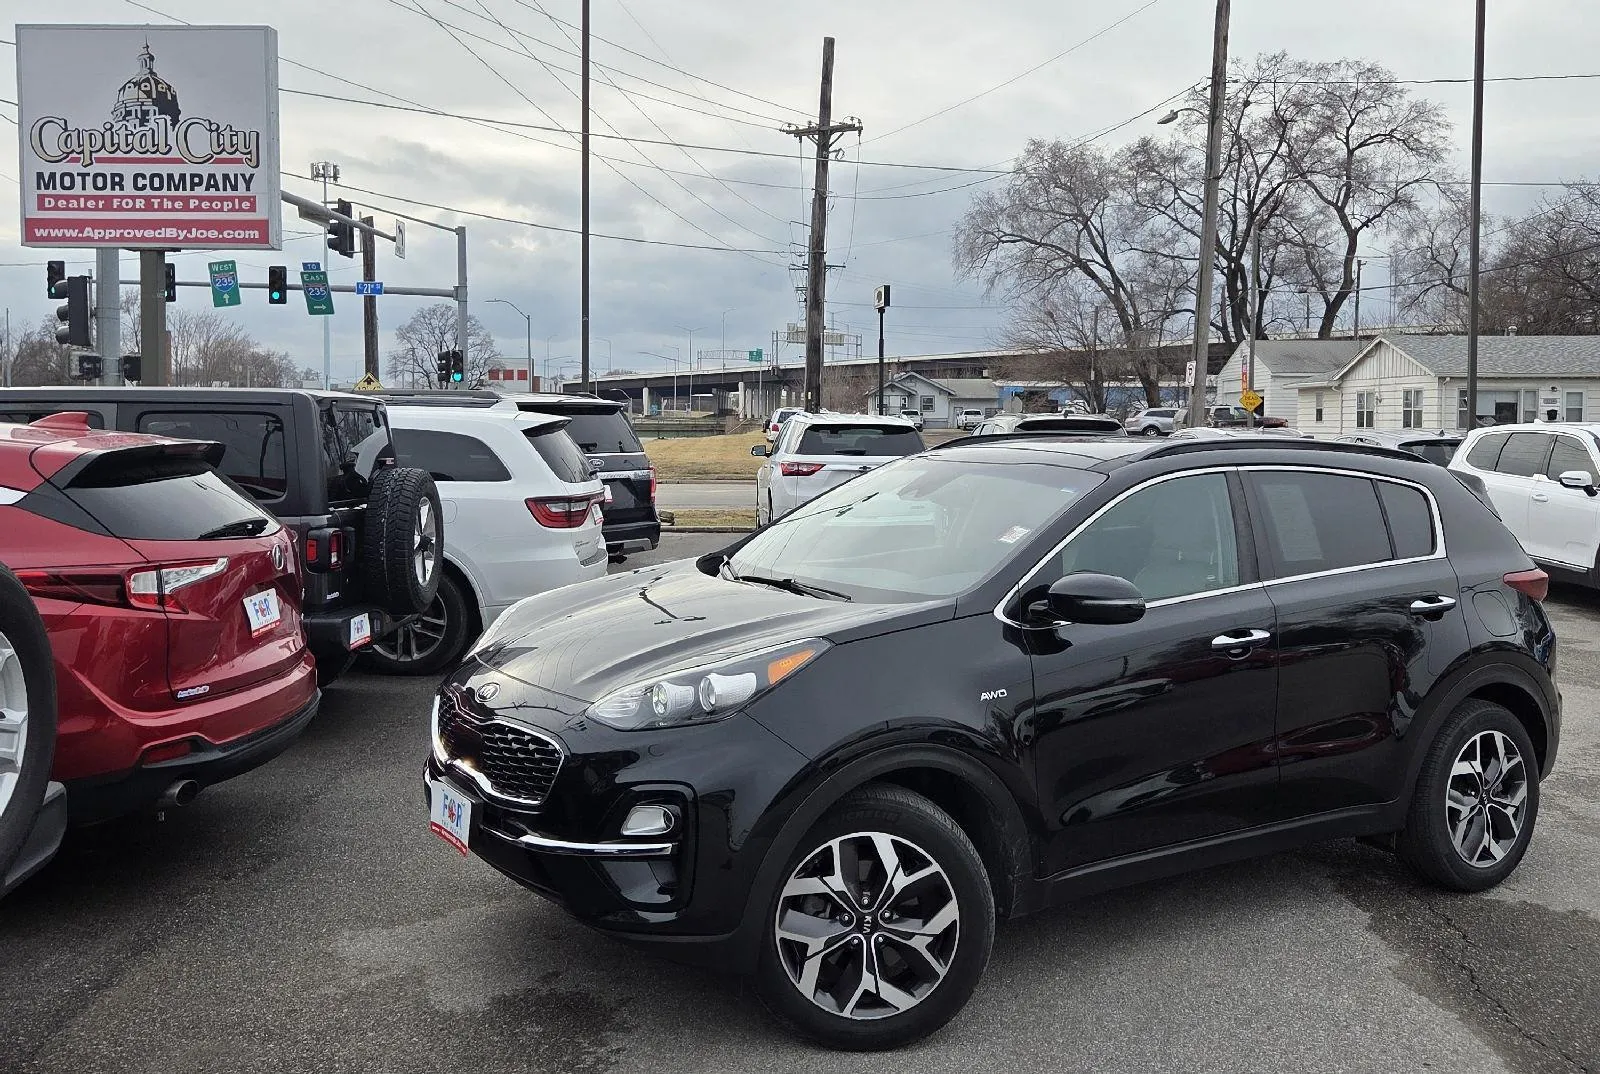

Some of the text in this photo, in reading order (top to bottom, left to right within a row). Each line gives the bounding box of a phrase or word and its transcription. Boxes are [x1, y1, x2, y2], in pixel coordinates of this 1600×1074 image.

[30, 116, 260, 169] Capital City
[36, 171, 255, 192] MOTOR COMPANY
[44, 197, 105, 208] Dealer
[112, 198, 146, 209] FOR
[151, 198, 184, 209] The
[34, 227, 259, 240] www.ApprovedByJoe.com
[211, 263, 233, 271] WEST
[215, 277, 235, 287] 235
[308, 287, 327, 296] 235
[980, 688, 1008, 701] AWD
[862, 915, 872, 934] KIA
